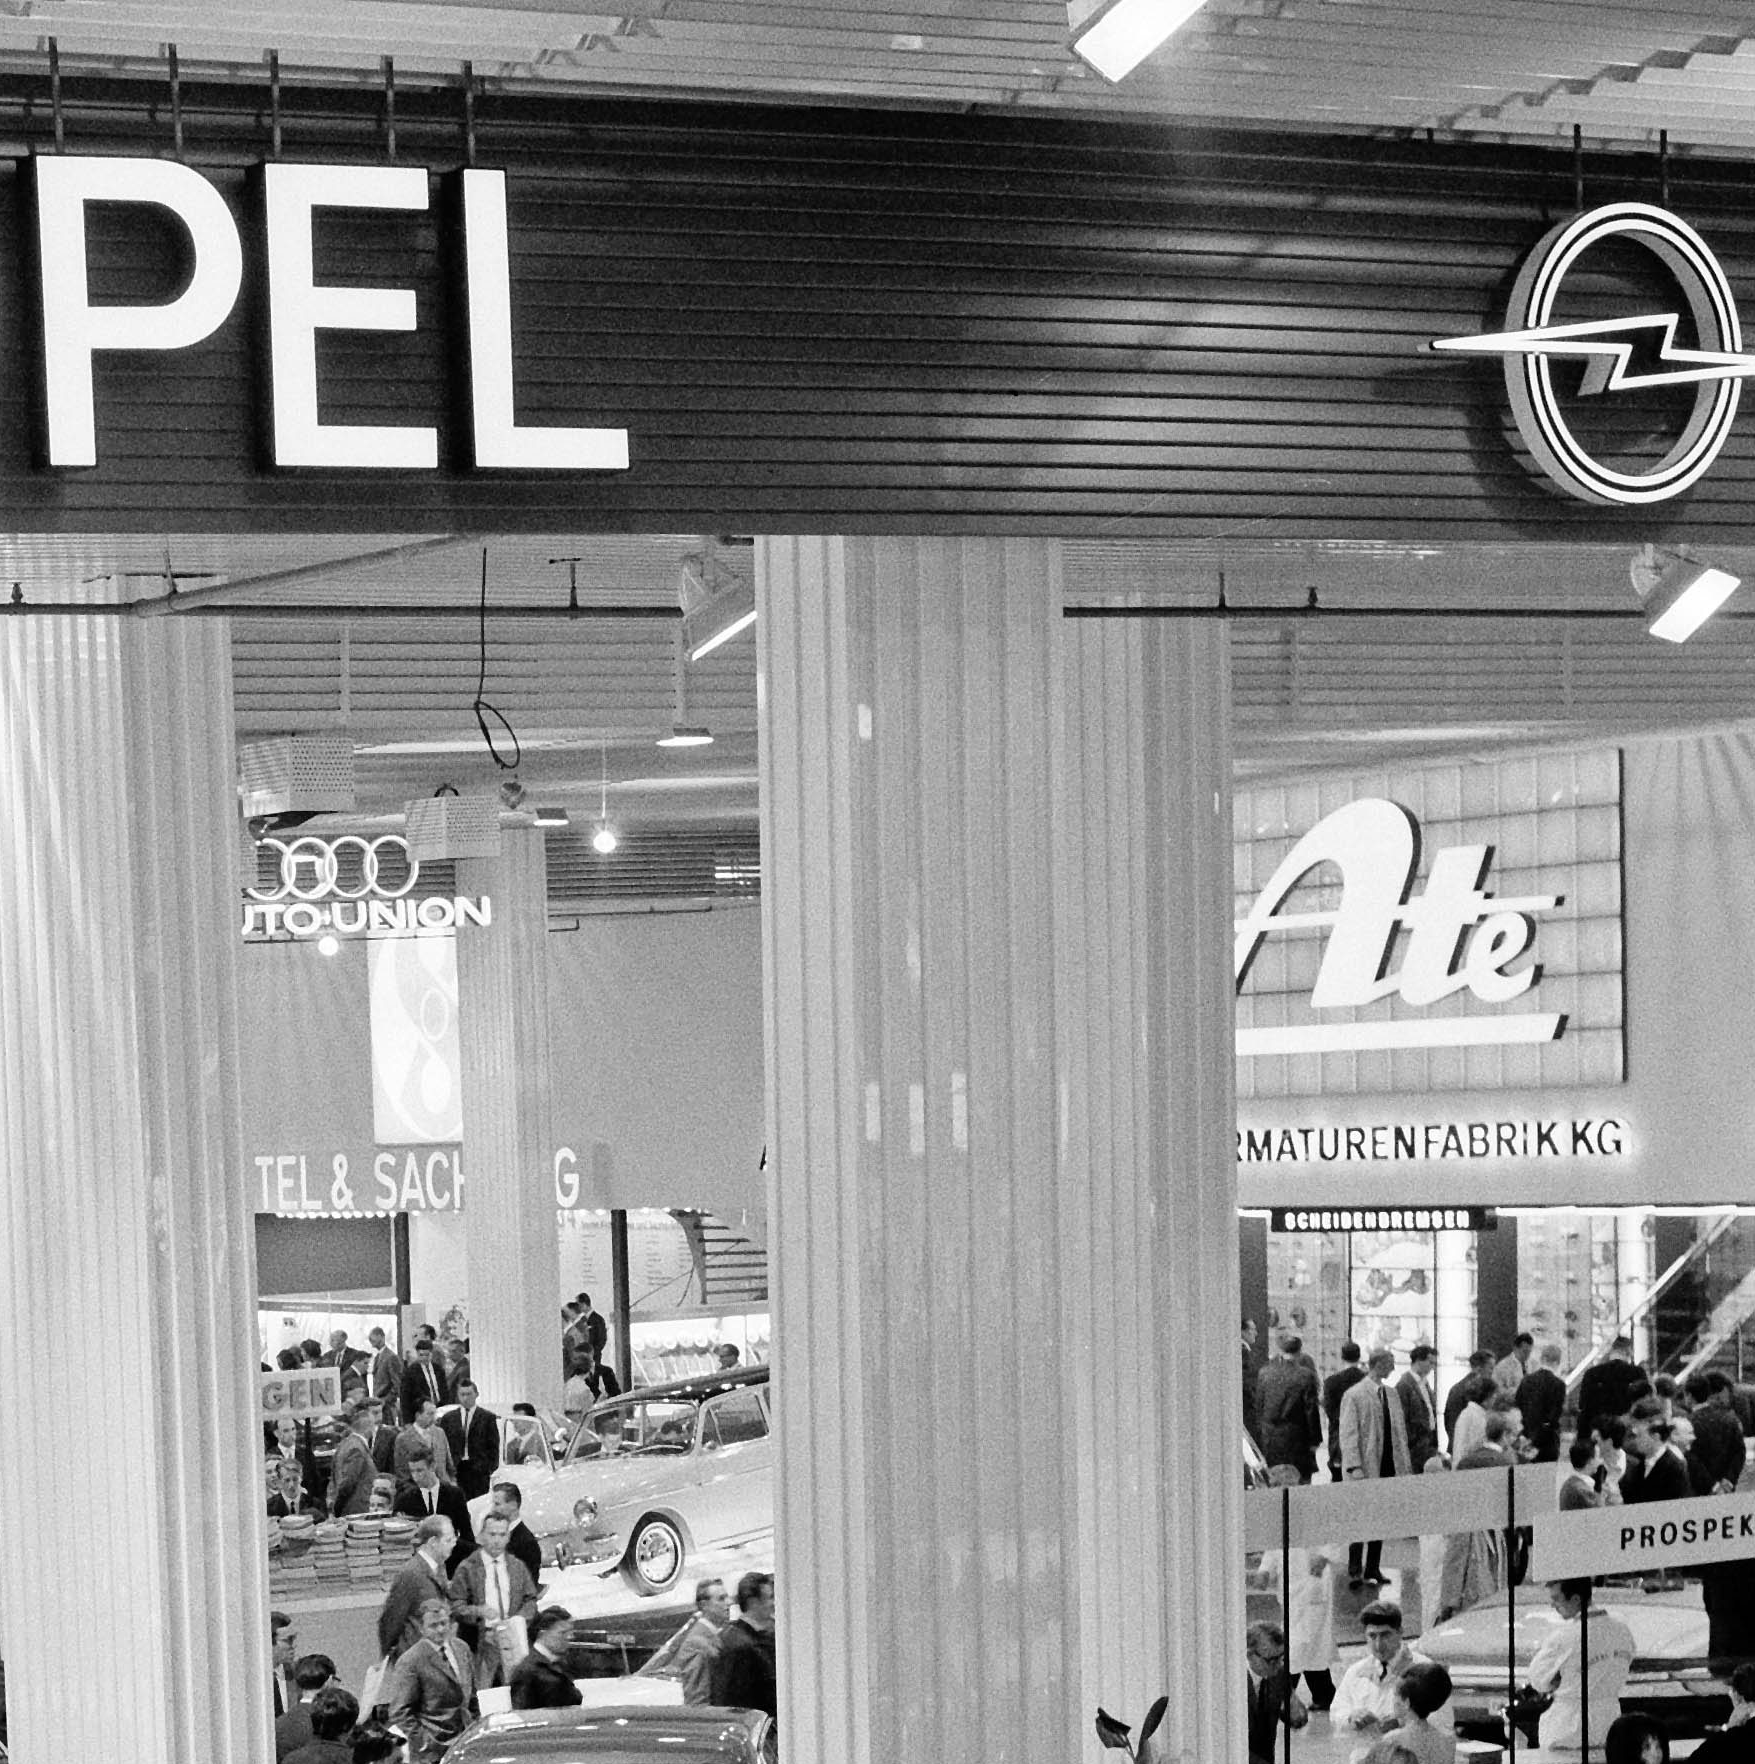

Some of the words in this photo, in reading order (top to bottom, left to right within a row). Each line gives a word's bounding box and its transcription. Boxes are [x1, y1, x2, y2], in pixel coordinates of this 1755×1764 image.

[331, 896, 493, 934] UNION
[1234, 798, 1560, 1008] Ate
[1237, 1121, 1560, 1163] MATURENFABRIK
[1571, 1119, 1623, 1157] KG
[331, 1153, 355, 1211] &
[261, 1376, 336, 1412] GEN
[1620, 1513, 1754, 1551] PROSPEK
